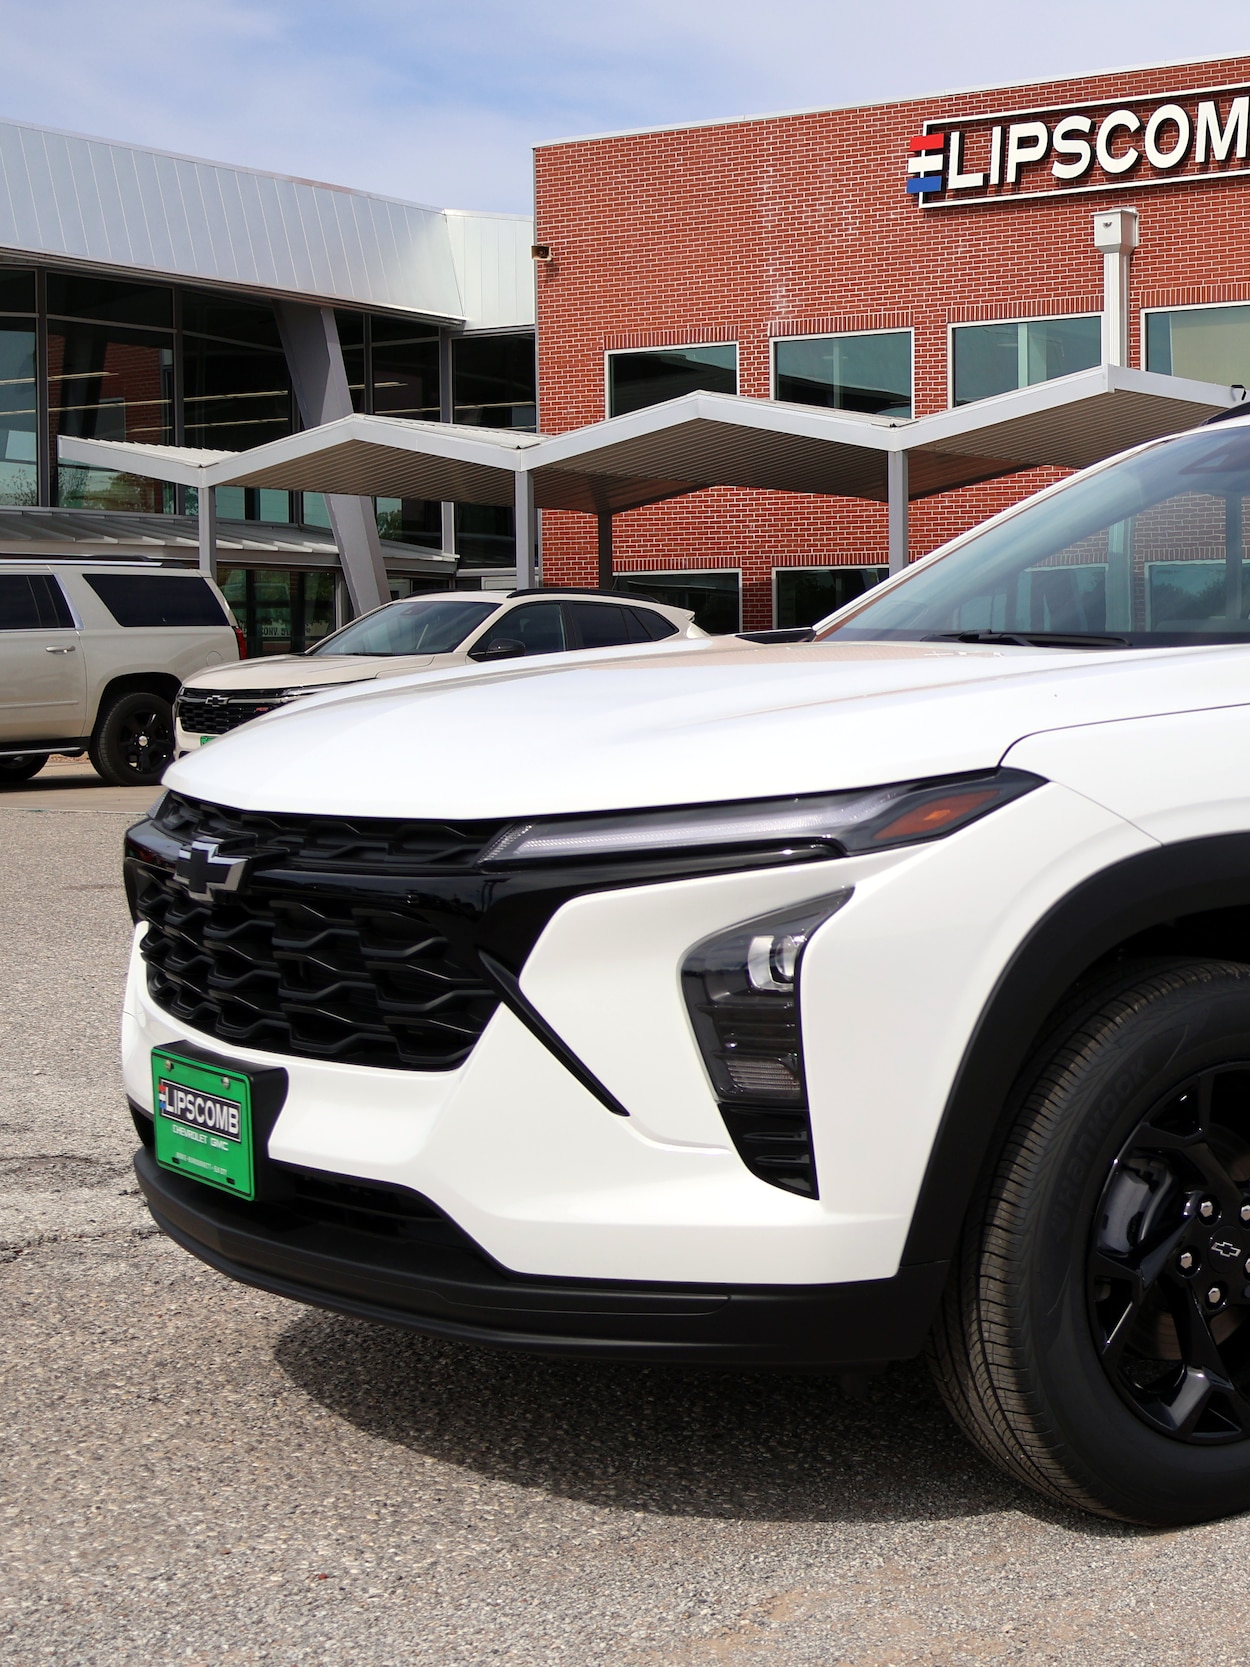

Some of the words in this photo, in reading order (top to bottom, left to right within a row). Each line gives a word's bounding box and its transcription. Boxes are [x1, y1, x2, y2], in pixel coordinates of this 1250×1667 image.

[164, 1086, 240, 1135] LIPSCOMB
[172, 1124, 208, 1144] CHEVROLET
[210, 1138, 229, 1151] GMC
